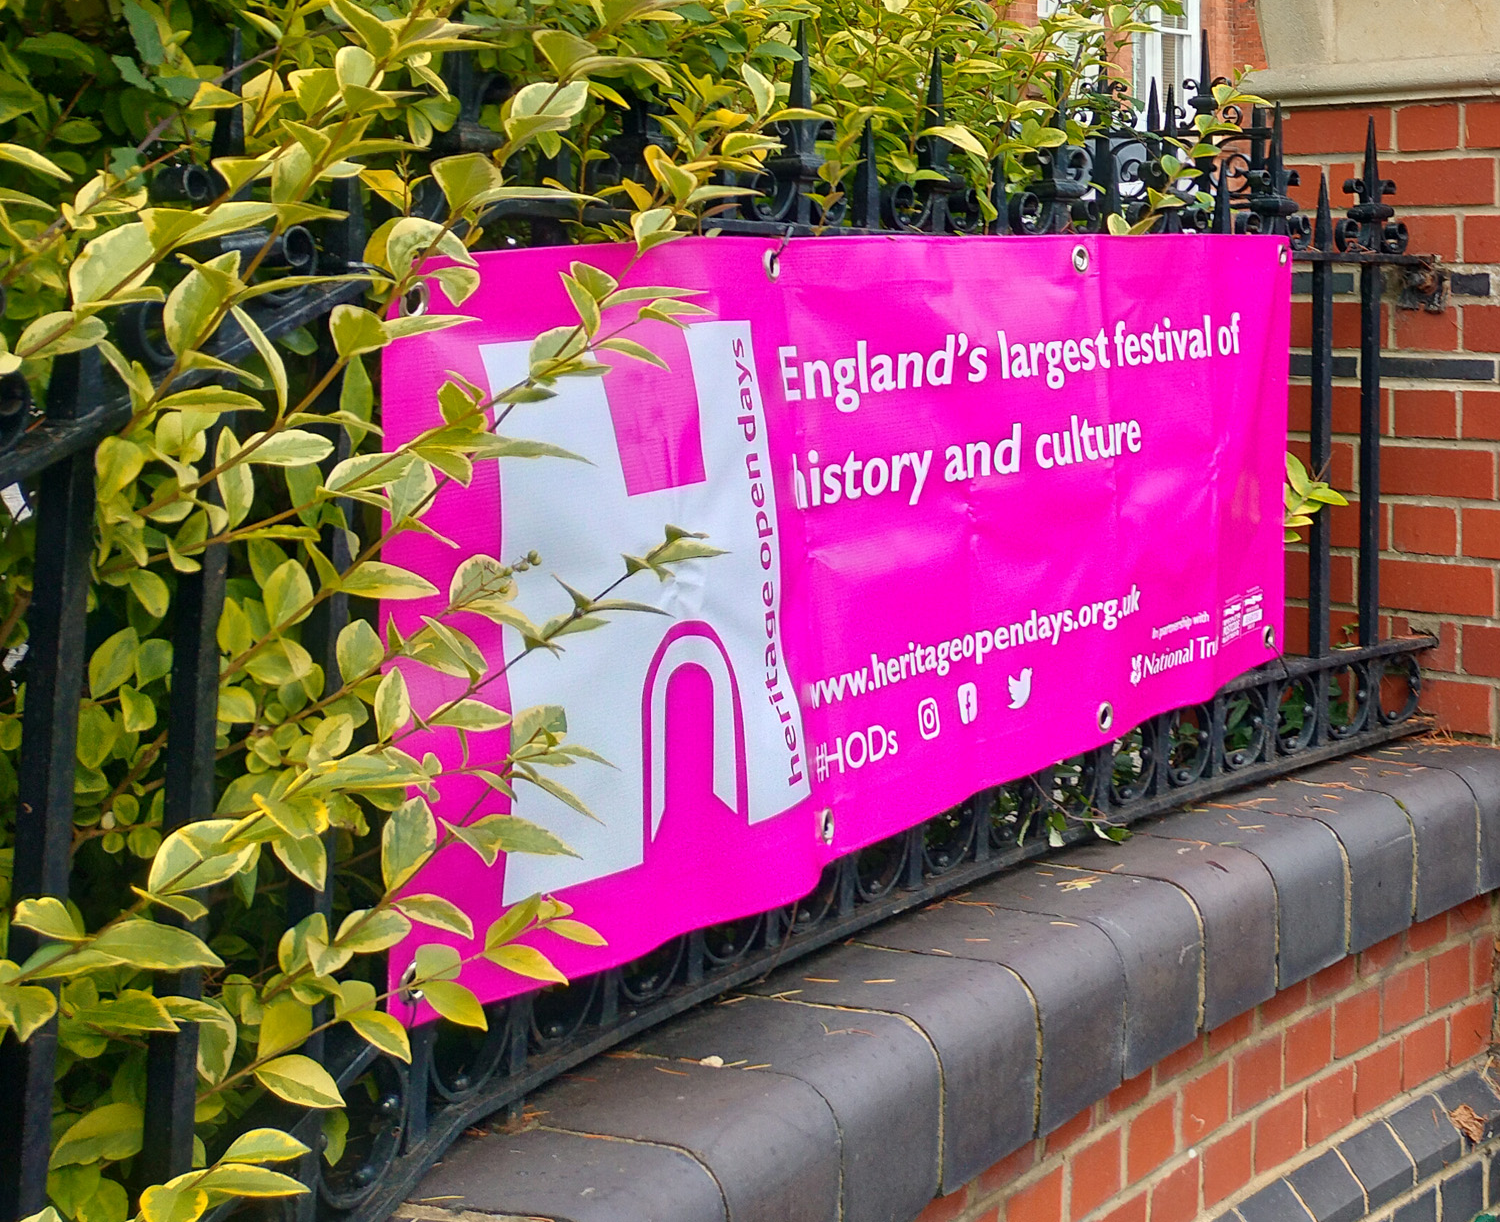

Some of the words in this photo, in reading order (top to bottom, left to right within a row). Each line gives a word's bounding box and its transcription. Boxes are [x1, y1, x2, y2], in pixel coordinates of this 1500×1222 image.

[732, 337, 757, 442] days
[778, 331, 989, 413] England's
[997, 328, 1111, 390] largest
[1114, 315, 1214, 367] festival
[1217, 312, 1241, 355] of
[746, 452, 774, 570] open
[792, 448, 933, 511] history
[945, 423, 1021, 483] and
[1035, 414, 1143, 469] culture
[762, 581, 803, 786] heritage
[1143, 639, 1194, 678] National
[1196, 635, 1219, 660] Tru
[816, 724, 899, 783] #HODs
